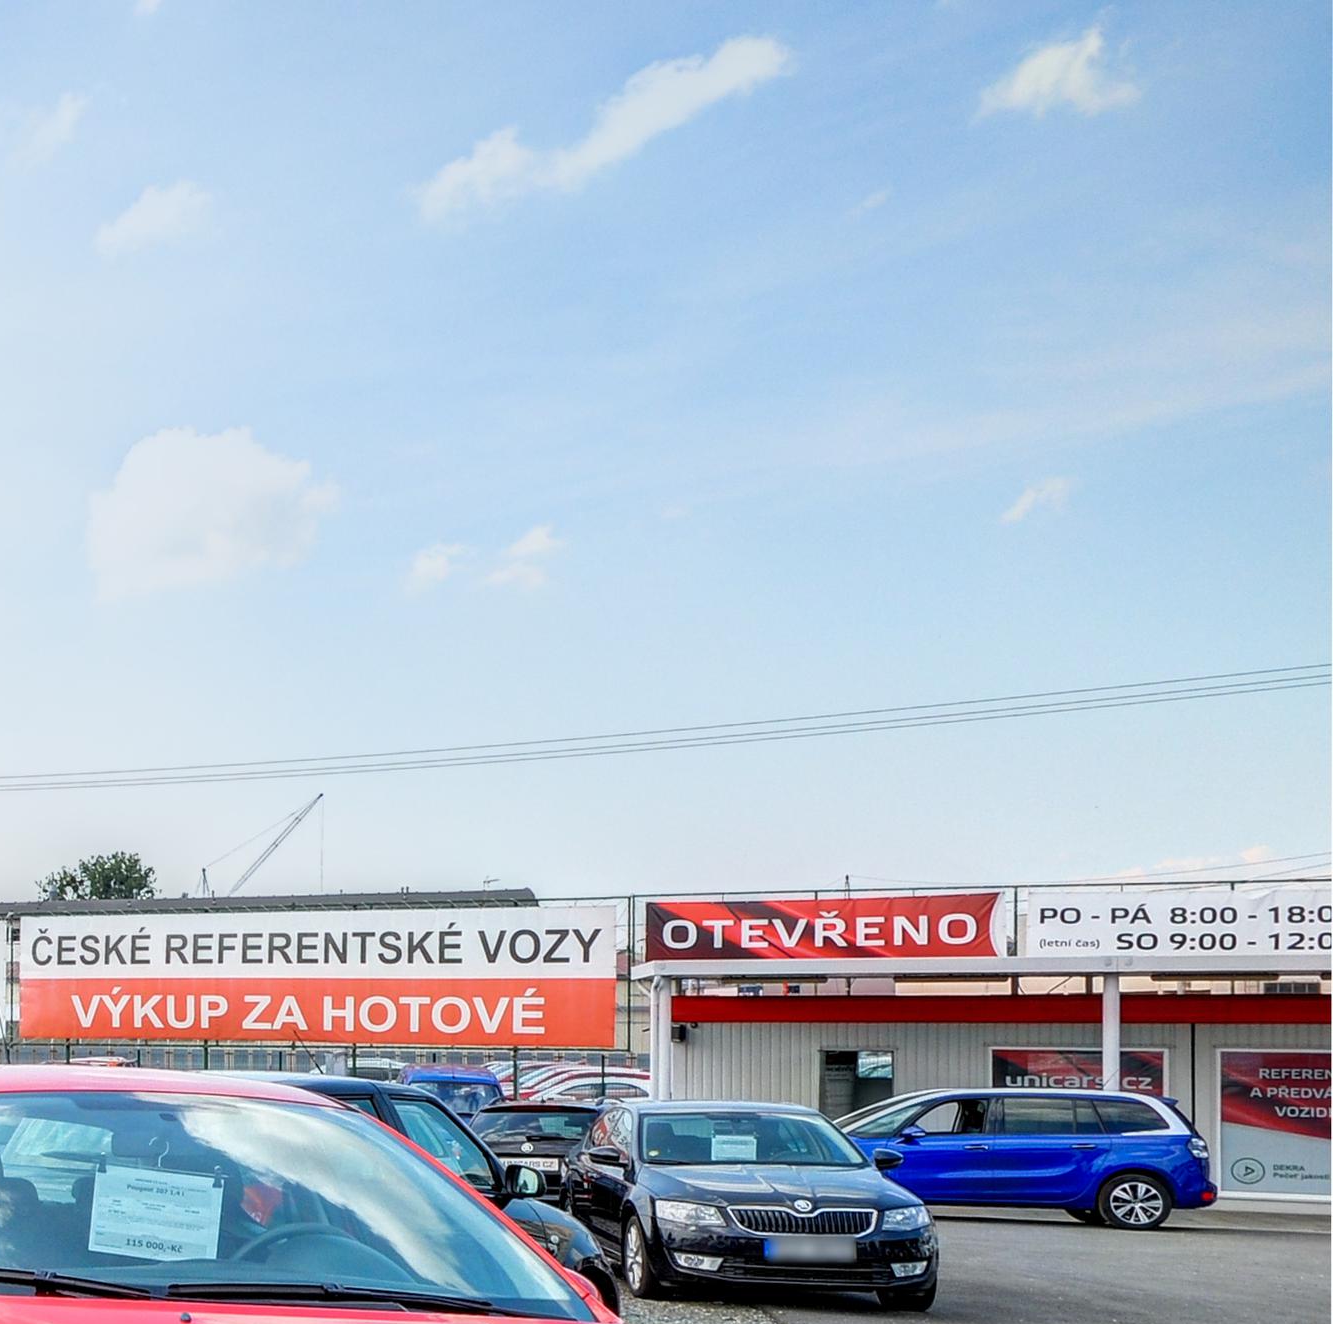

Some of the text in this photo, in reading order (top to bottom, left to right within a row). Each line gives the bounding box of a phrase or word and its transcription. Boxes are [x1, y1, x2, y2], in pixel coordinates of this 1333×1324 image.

[1039, 907, 1081, 924] PO
[1110, 904, 1152, 924] PÁ
[1169, 907, 1237, 924] 8:00
[31, 923, 602, 966] ČESKÉ REFERENTSKÉ VOZY
[660, 909, 979, 950] OTEVŘENO
[1039, 937, 1072, 949] (letní
[1075, 938, 1100, 949] čas)
[1116, 933, 1158, 950] SO
[1169, 933, 1237, 950] 9:00
[71, 986, 546, 1034] VÝKUP ZA HOTOVÉ
[1250, 1088, 1263, 1098] A
